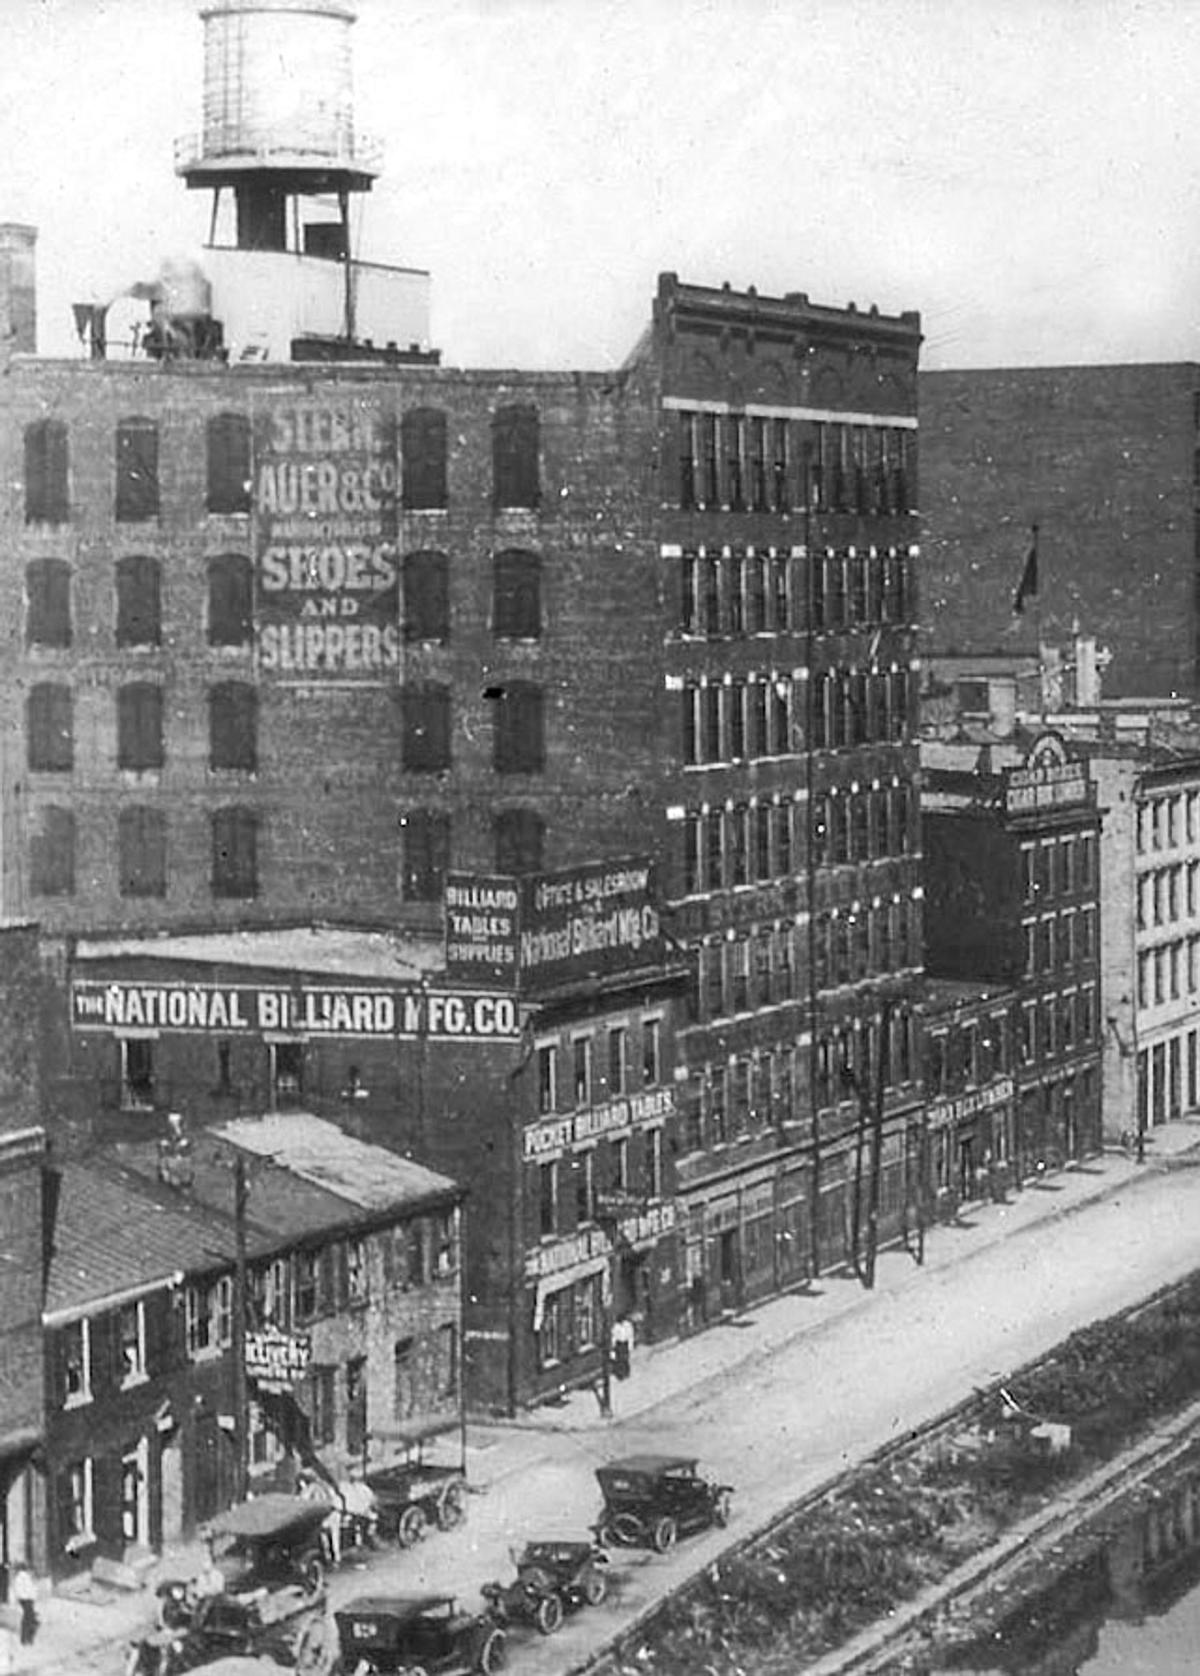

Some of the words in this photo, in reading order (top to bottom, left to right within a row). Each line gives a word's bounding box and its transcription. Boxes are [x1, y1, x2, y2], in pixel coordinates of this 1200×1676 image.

[259, 465, 338, 513] AUER
[262, 546, 396, 590] SHOES
[300, 598, 359, 616] AND
[260, 624, 398, 672] SLIPPERS
[447, 886, 518, 910] BILLIARD
[452, 916, 511, 937] TABLES
[105, 989, 249, 1027] NATIONAL
[257, 991, 395, 1032] BILLIARD
